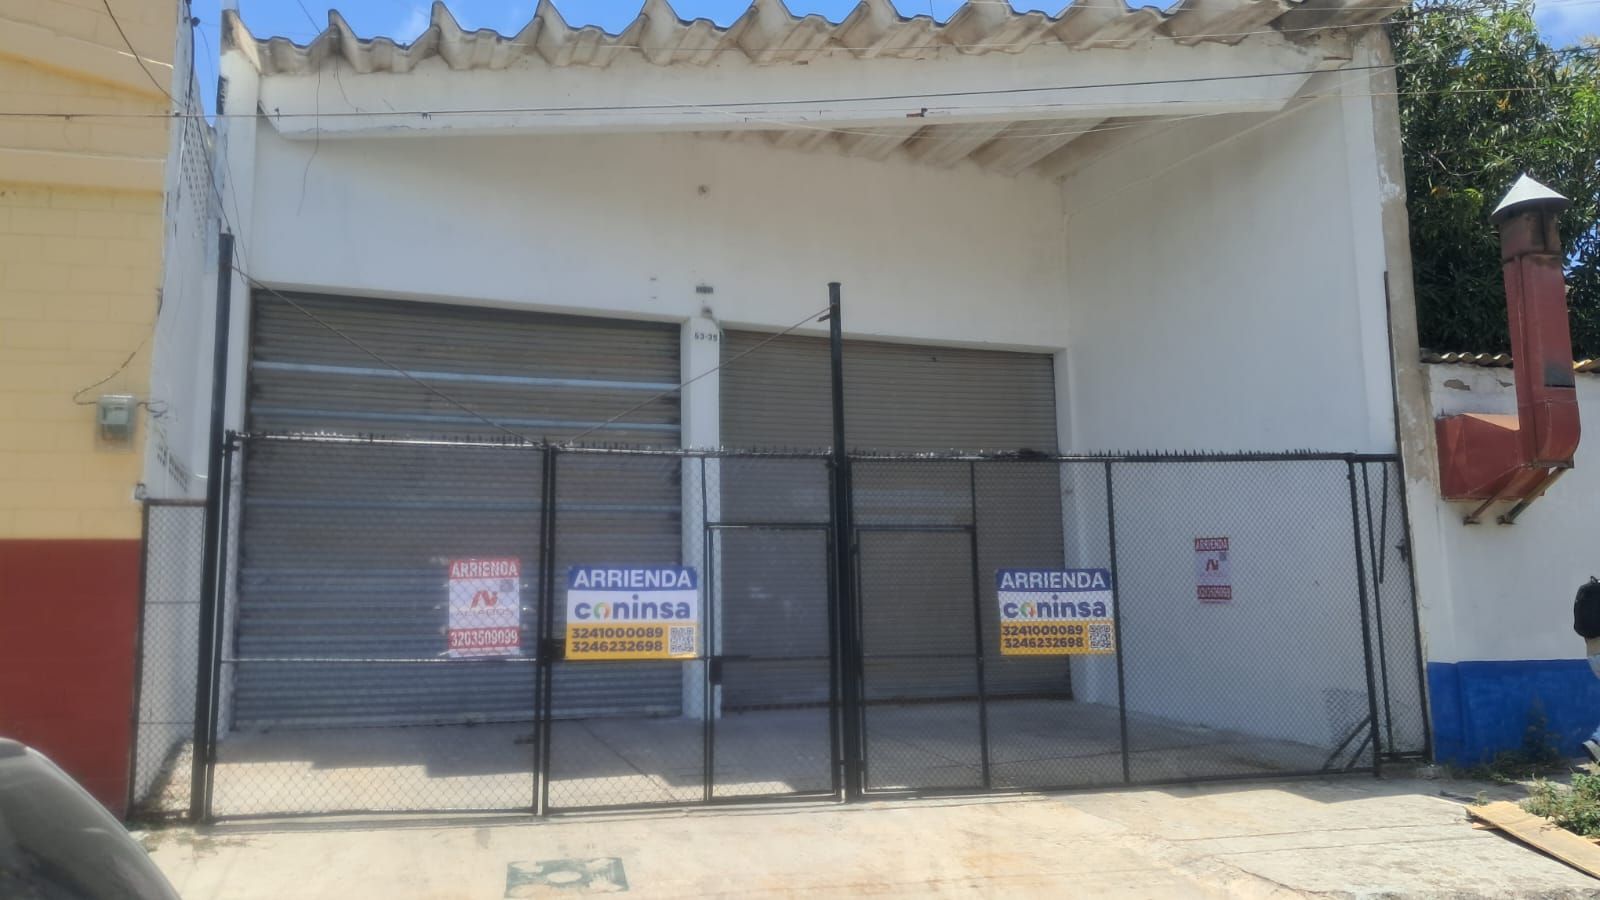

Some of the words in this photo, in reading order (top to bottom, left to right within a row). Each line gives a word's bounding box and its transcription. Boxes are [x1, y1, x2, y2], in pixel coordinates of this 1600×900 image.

[451, 561, 518, 578] ARRIENDA
[573, 569, 692, 588] ARRIENDA
[1000, 571, 1106, 589] ARRIENDA
[574, 594, 691, 620] coninsa
[1003, 594, 1107, 619] coninsa
[572, 627, 664, 639] 3241000089
[1003, 625, 1083, 636] 3241000089
[572, 641, 663, 653] 3246232698
[1004, 637, 1084, 649] 3246232698
